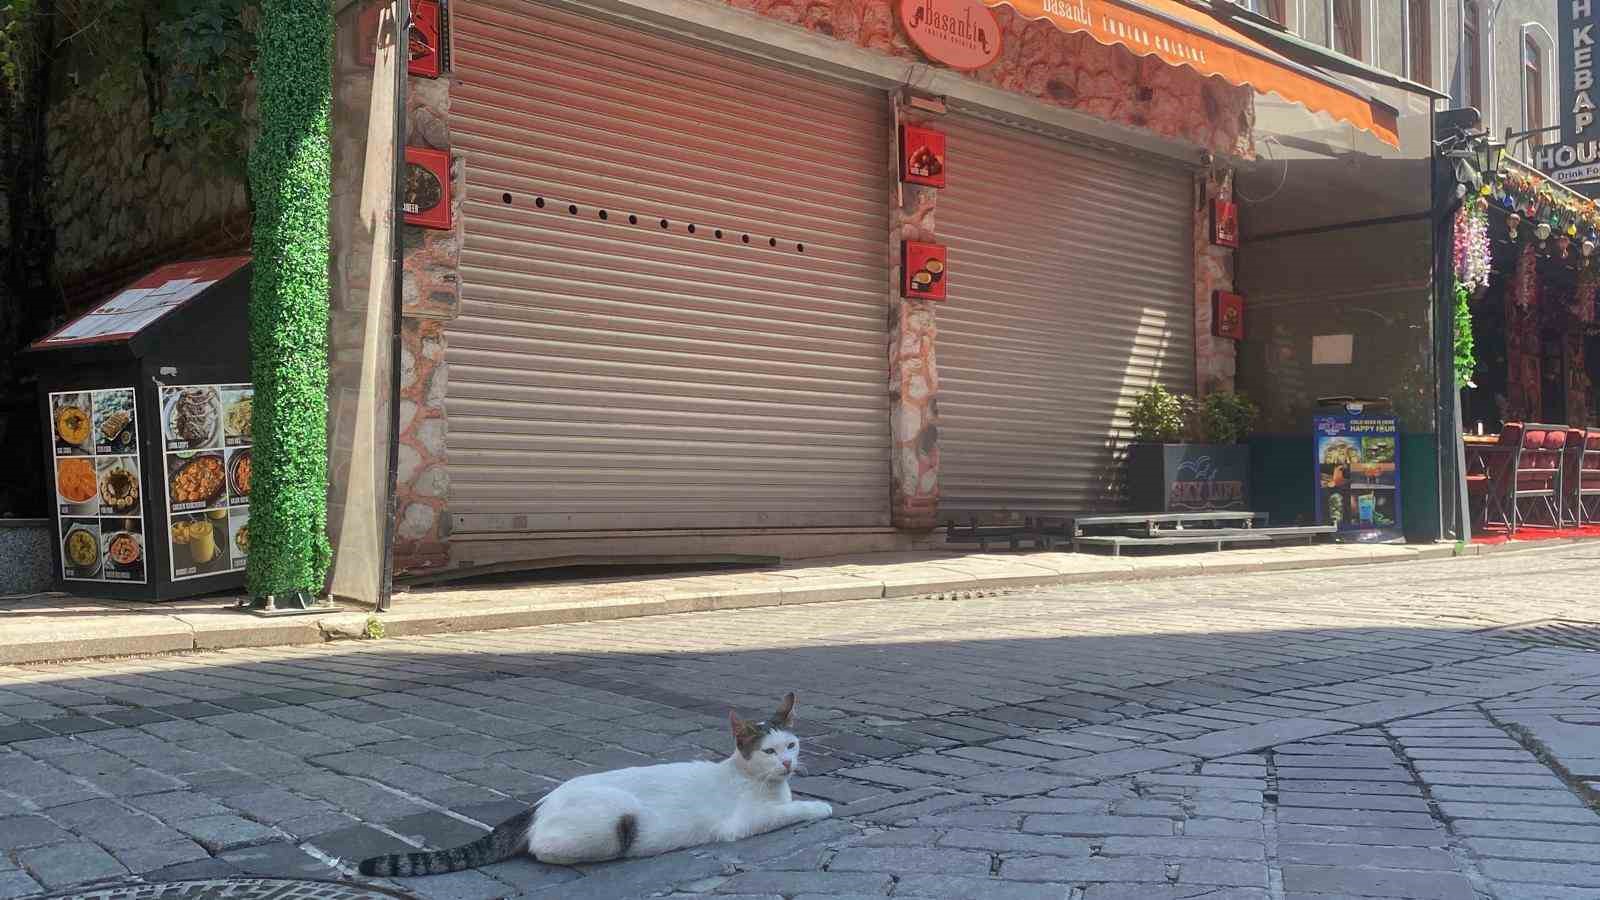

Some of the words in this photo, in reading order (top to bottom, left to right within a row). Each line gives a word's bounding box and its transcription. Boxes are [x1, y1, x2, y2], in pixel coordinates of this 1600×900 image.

[1572, 24, 1597, 135] KEBAP
[1536, 140, 1600, 170] HOU
[1558, 168, 1584, 180] Drink
[1350, 425, 1375, 433] HAPPY
